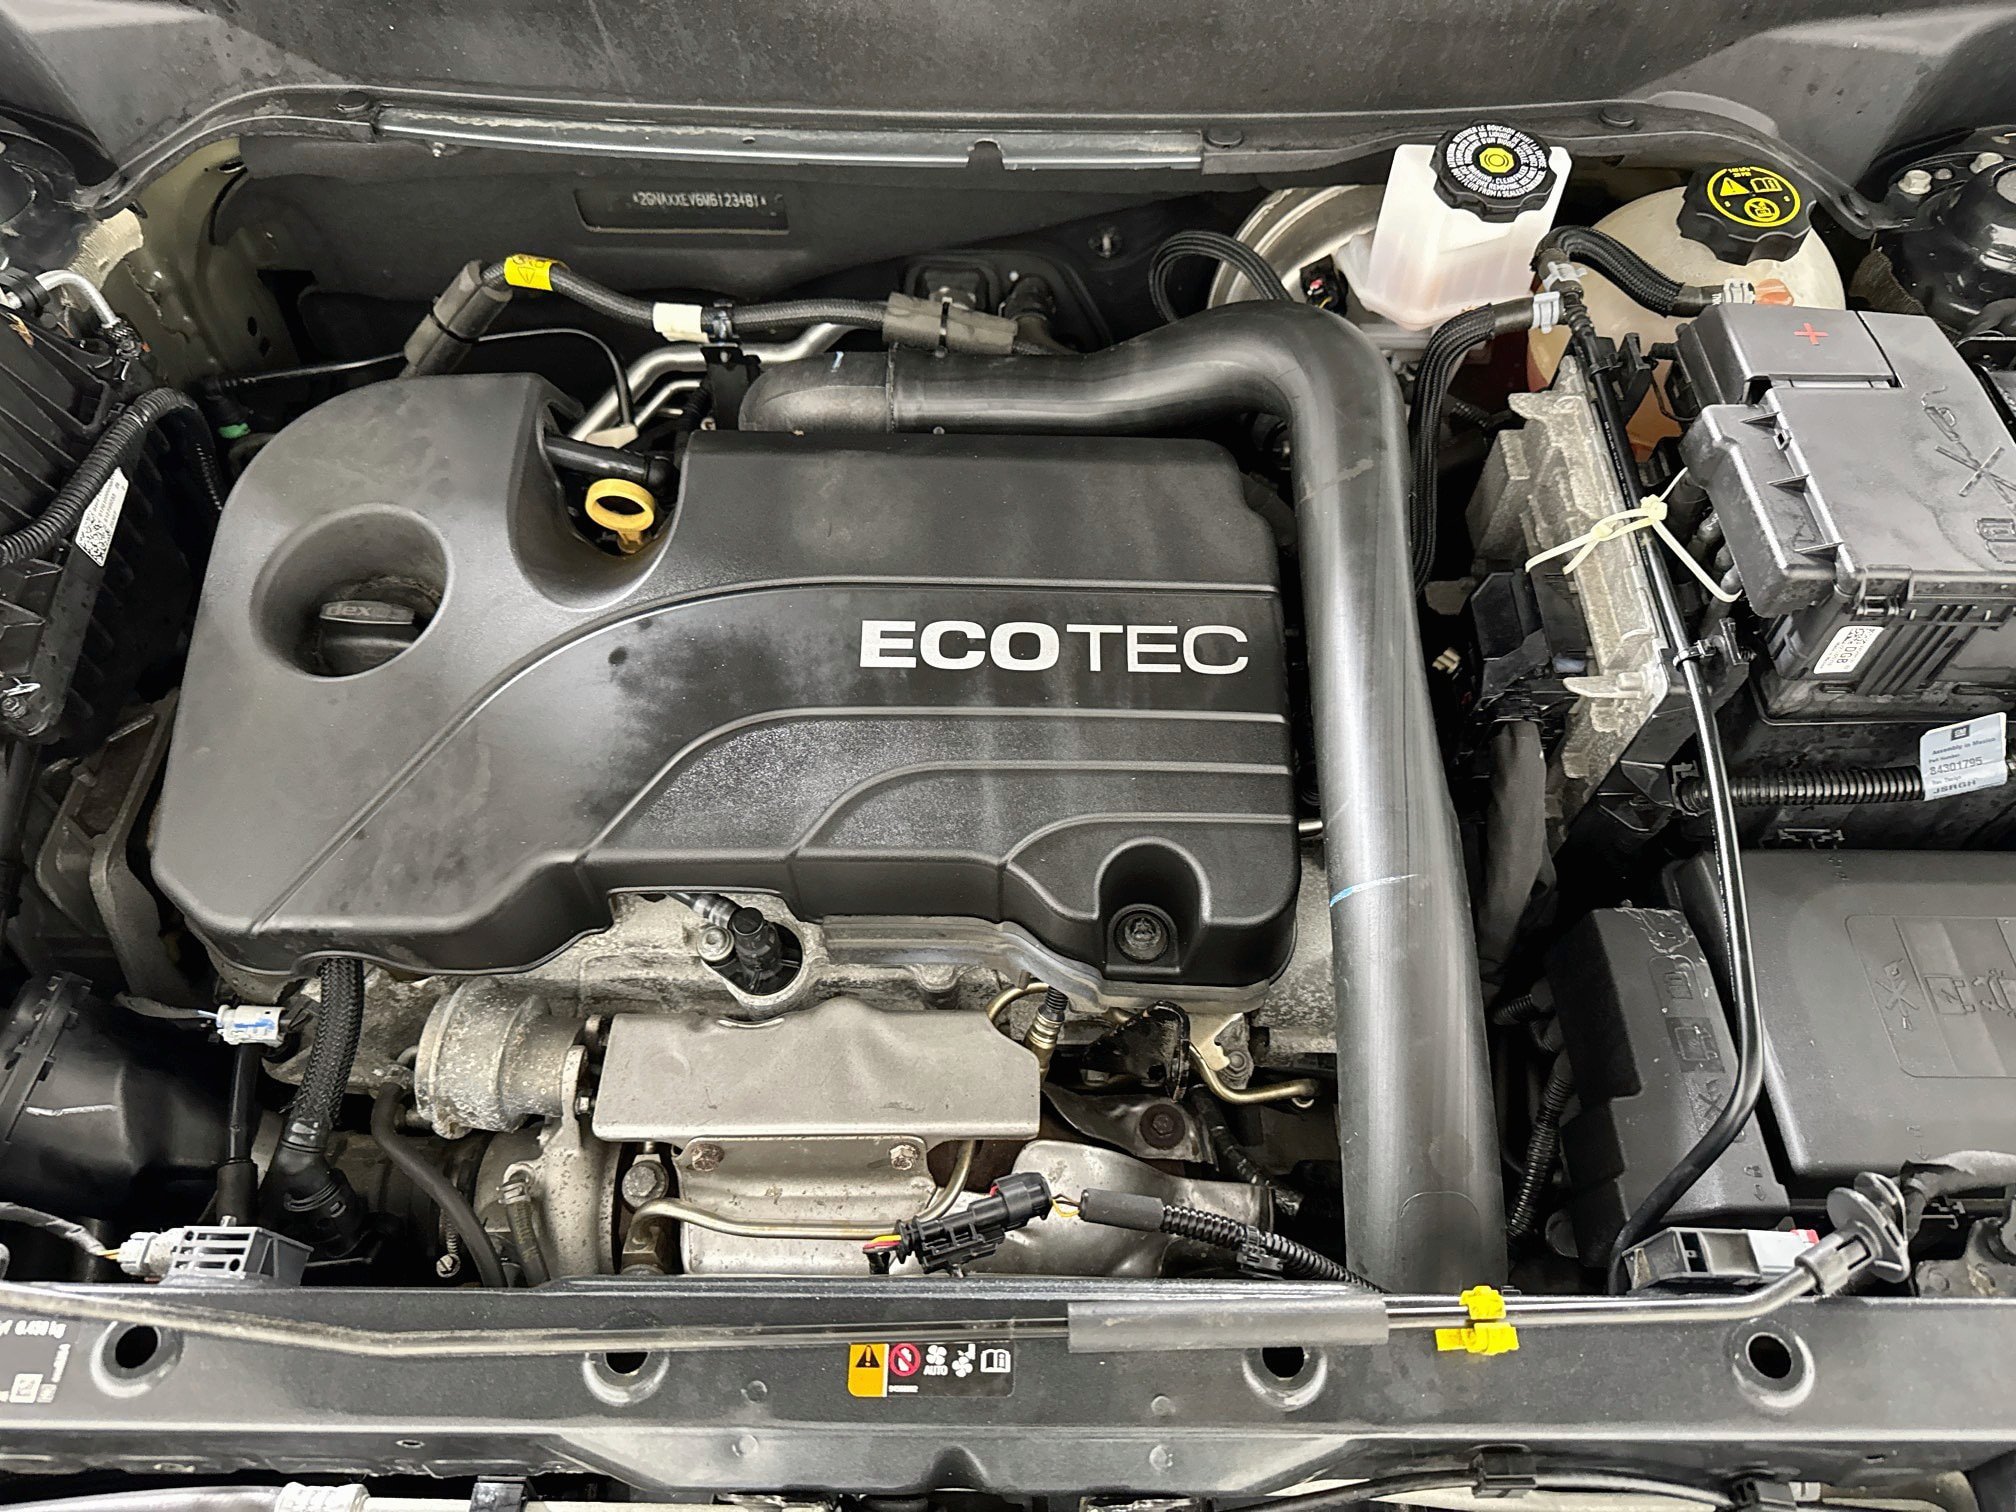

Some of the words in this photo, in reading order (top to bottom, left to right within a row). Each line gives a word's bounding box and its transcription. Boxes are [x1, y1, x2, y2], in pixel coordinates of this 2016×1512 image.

[859, 619, 1249, 675] ECOTEC
[1930, 757, 1983, 775] 84301795
[923, 1365, 949, 1376] AUTO
